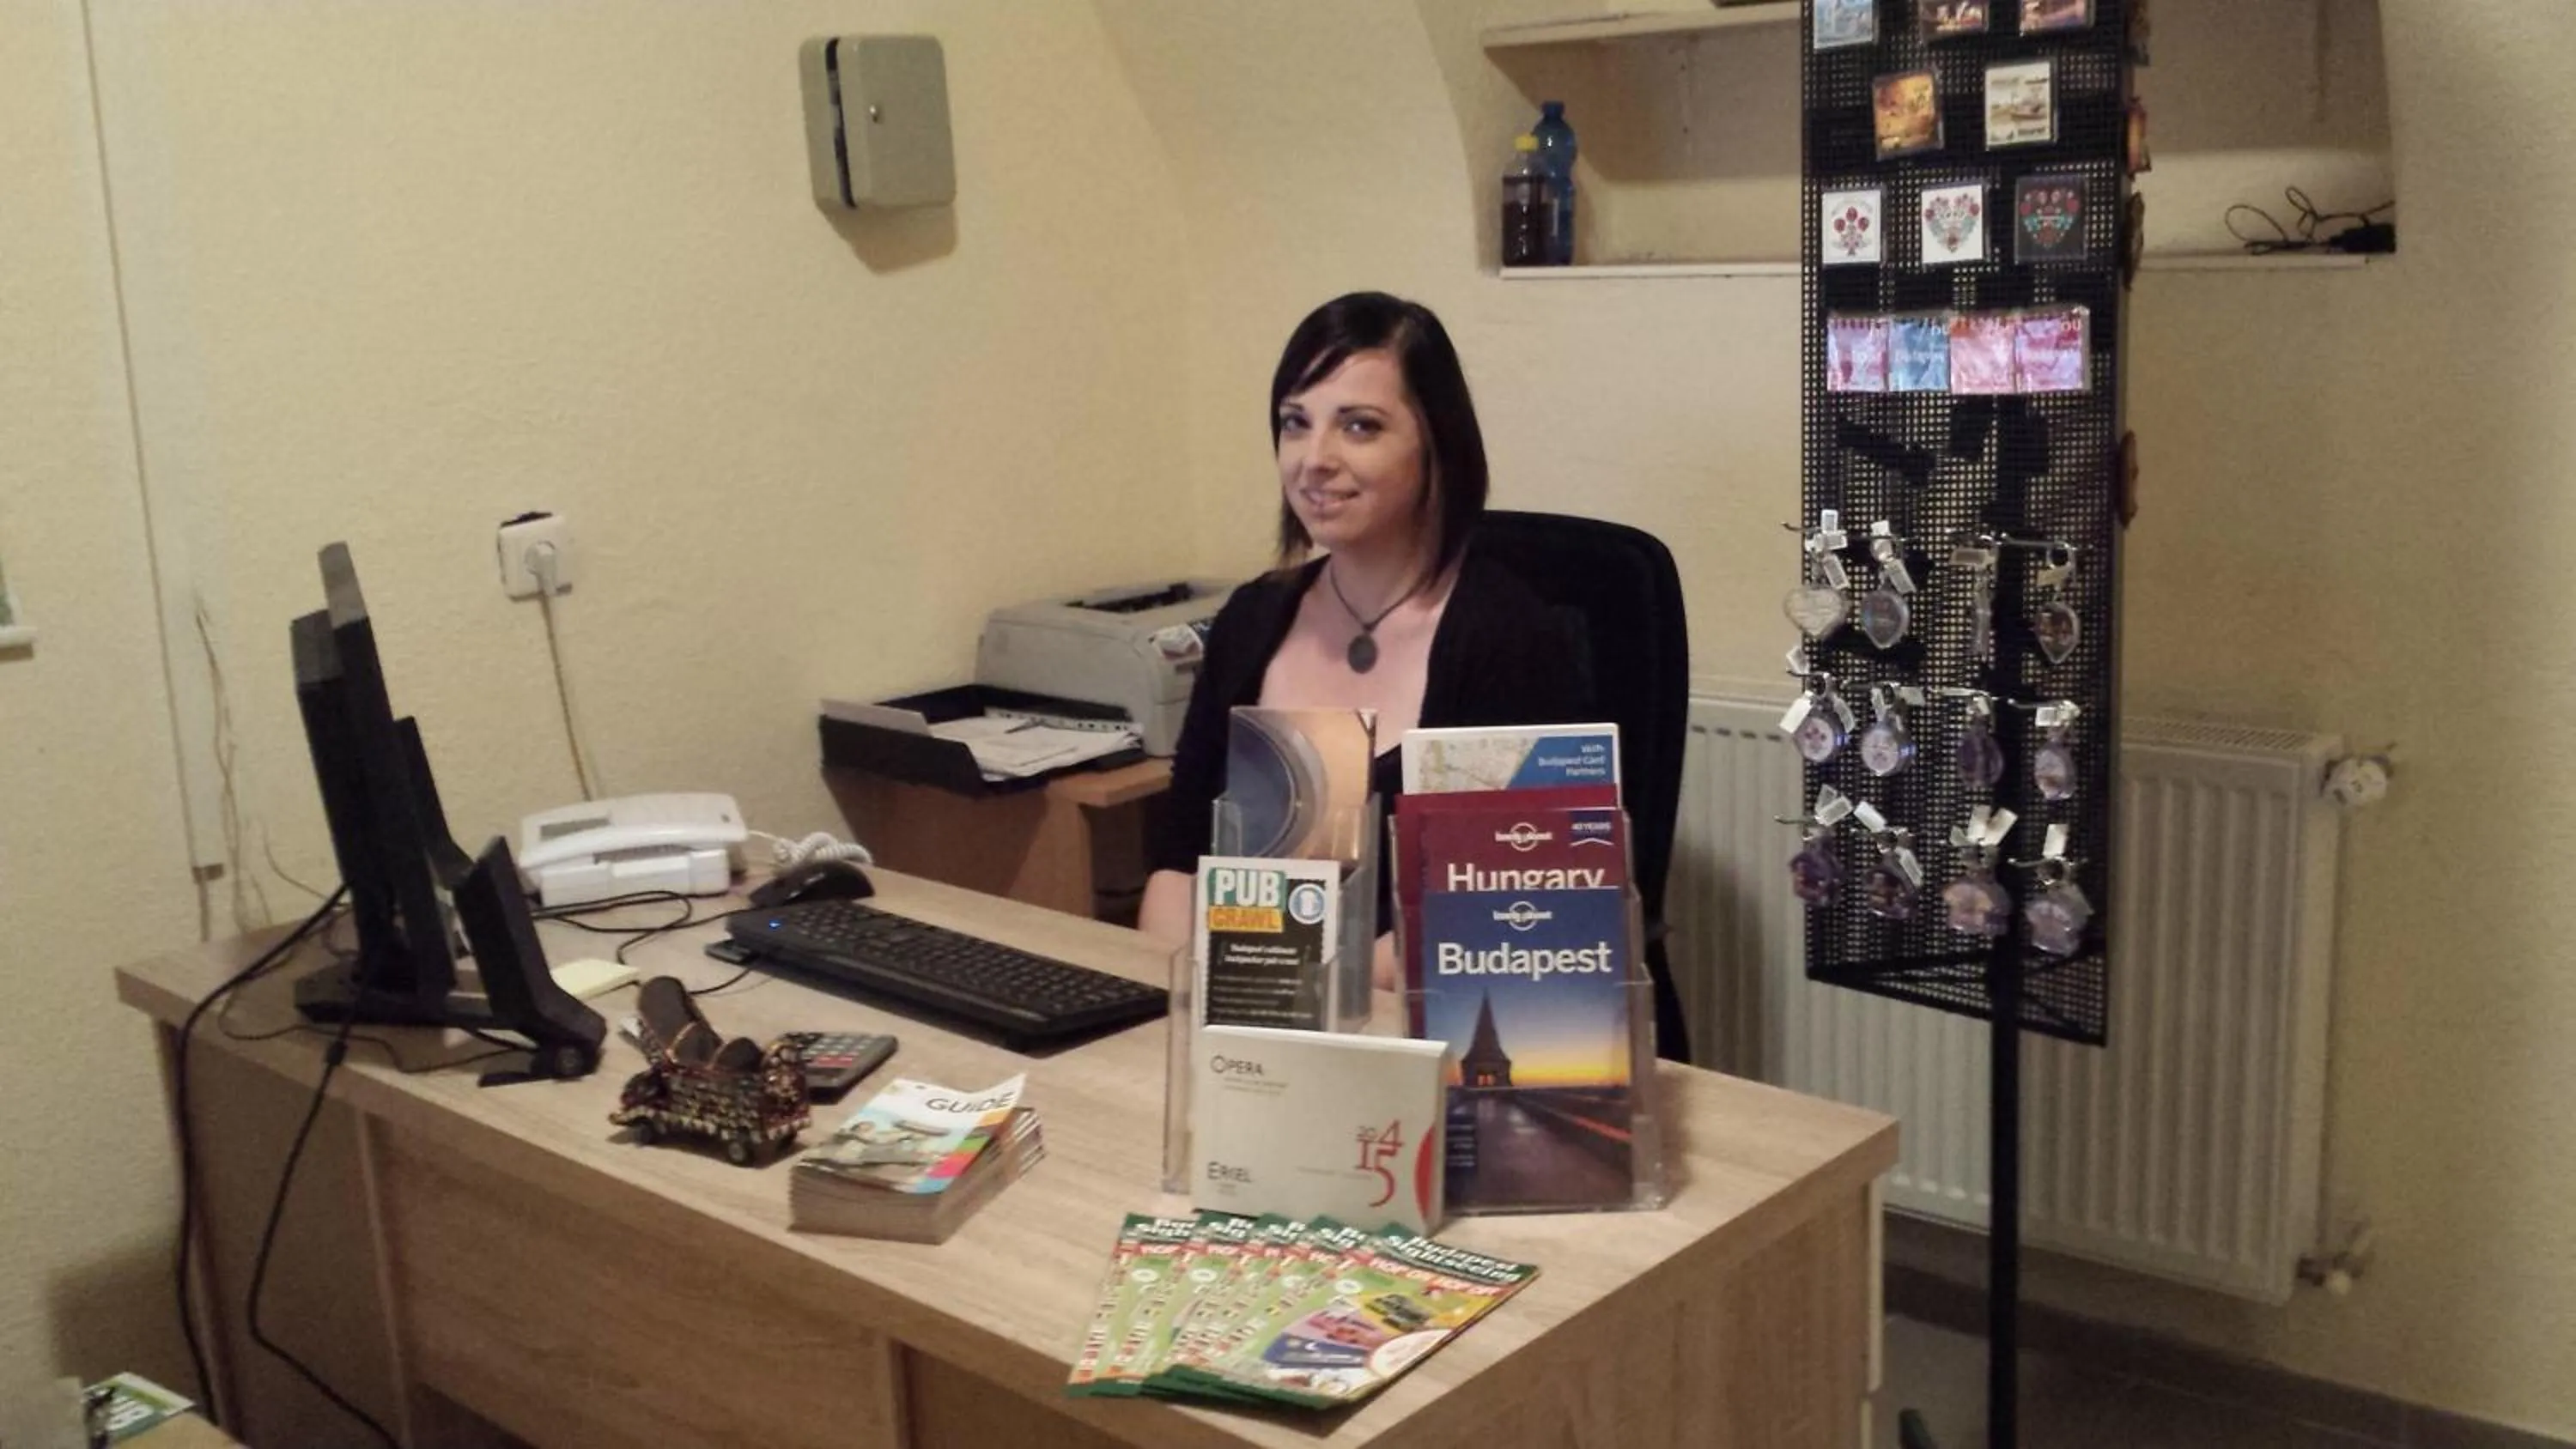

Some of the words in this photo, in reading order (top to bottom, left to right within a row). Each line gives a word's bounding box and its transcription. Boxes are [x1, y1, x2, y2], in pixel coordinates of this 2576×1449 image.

[1214, 868, 1279, 906] PUB
[1447, 862, 1606, 892] Hungary
[1437, 942, 1613, 981] Budapest
[1209, 1054, 1264, 1076] OPERA
[926, 1091, 1015, 1113] GUIDE
